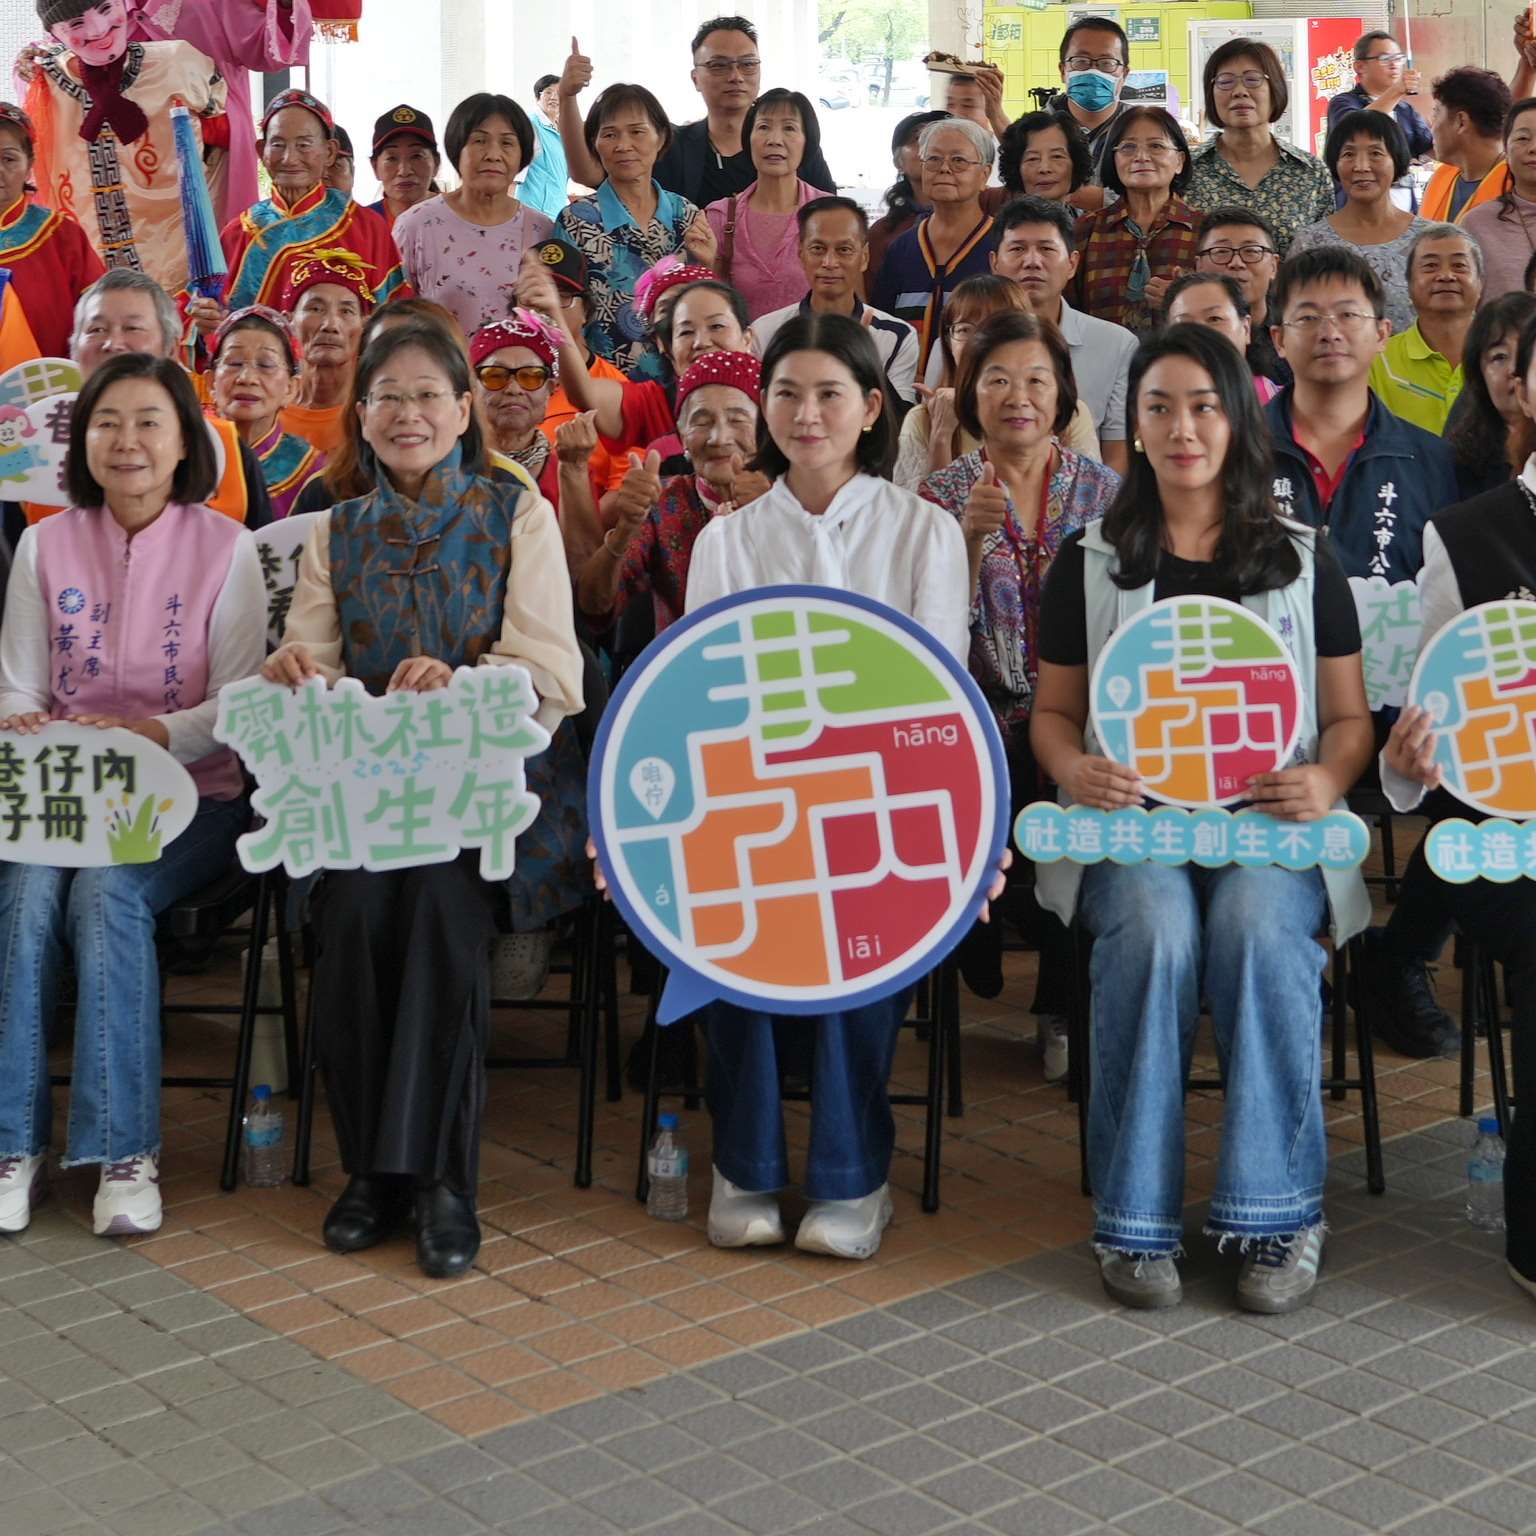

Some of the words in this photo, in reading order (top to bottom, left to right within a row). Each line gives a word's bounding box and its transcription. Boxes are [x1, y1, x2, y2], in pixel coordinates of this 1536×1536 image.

[81, 602, 112, 679] 副主席
[161, 593, 184, 712] 斗六市民代
[225, 676, 540, 765] 雲林社造
[893, 722, 958, 750] hāng
[352, 750, 432, 779] 2025
[248, 770, 530, 871] 創生年
[1024, 816, 1356, 862] 社造共生創生不息
[847, 935, 882, 960] lāi
